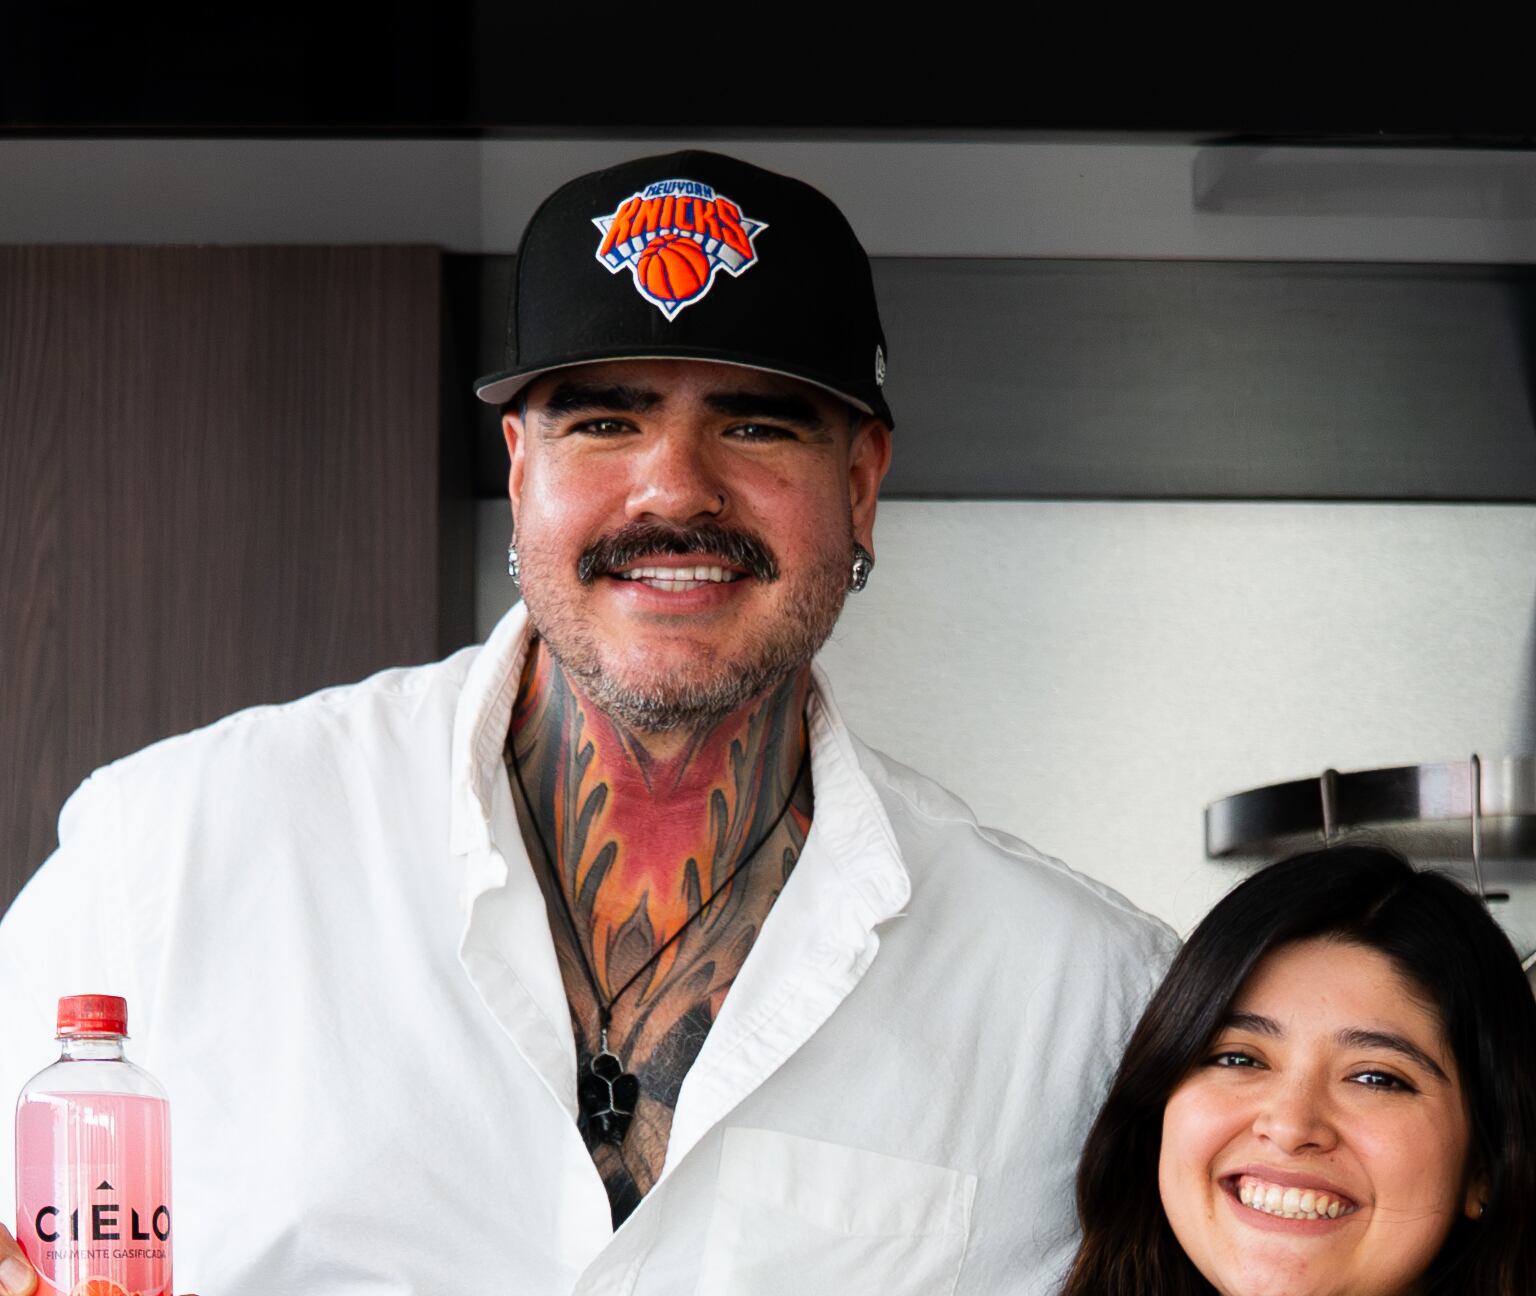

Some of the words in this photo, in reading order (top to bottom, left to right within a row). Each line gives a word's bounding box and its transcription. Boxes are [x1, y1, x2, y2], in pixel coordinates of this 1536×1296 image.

[645, 182, 676, 198] NEW
[677, 181, 713, 199] YORK
[600, 195, 754, 260] KNICKS
[113, 1248, 167, 1259] GASIFICADA
